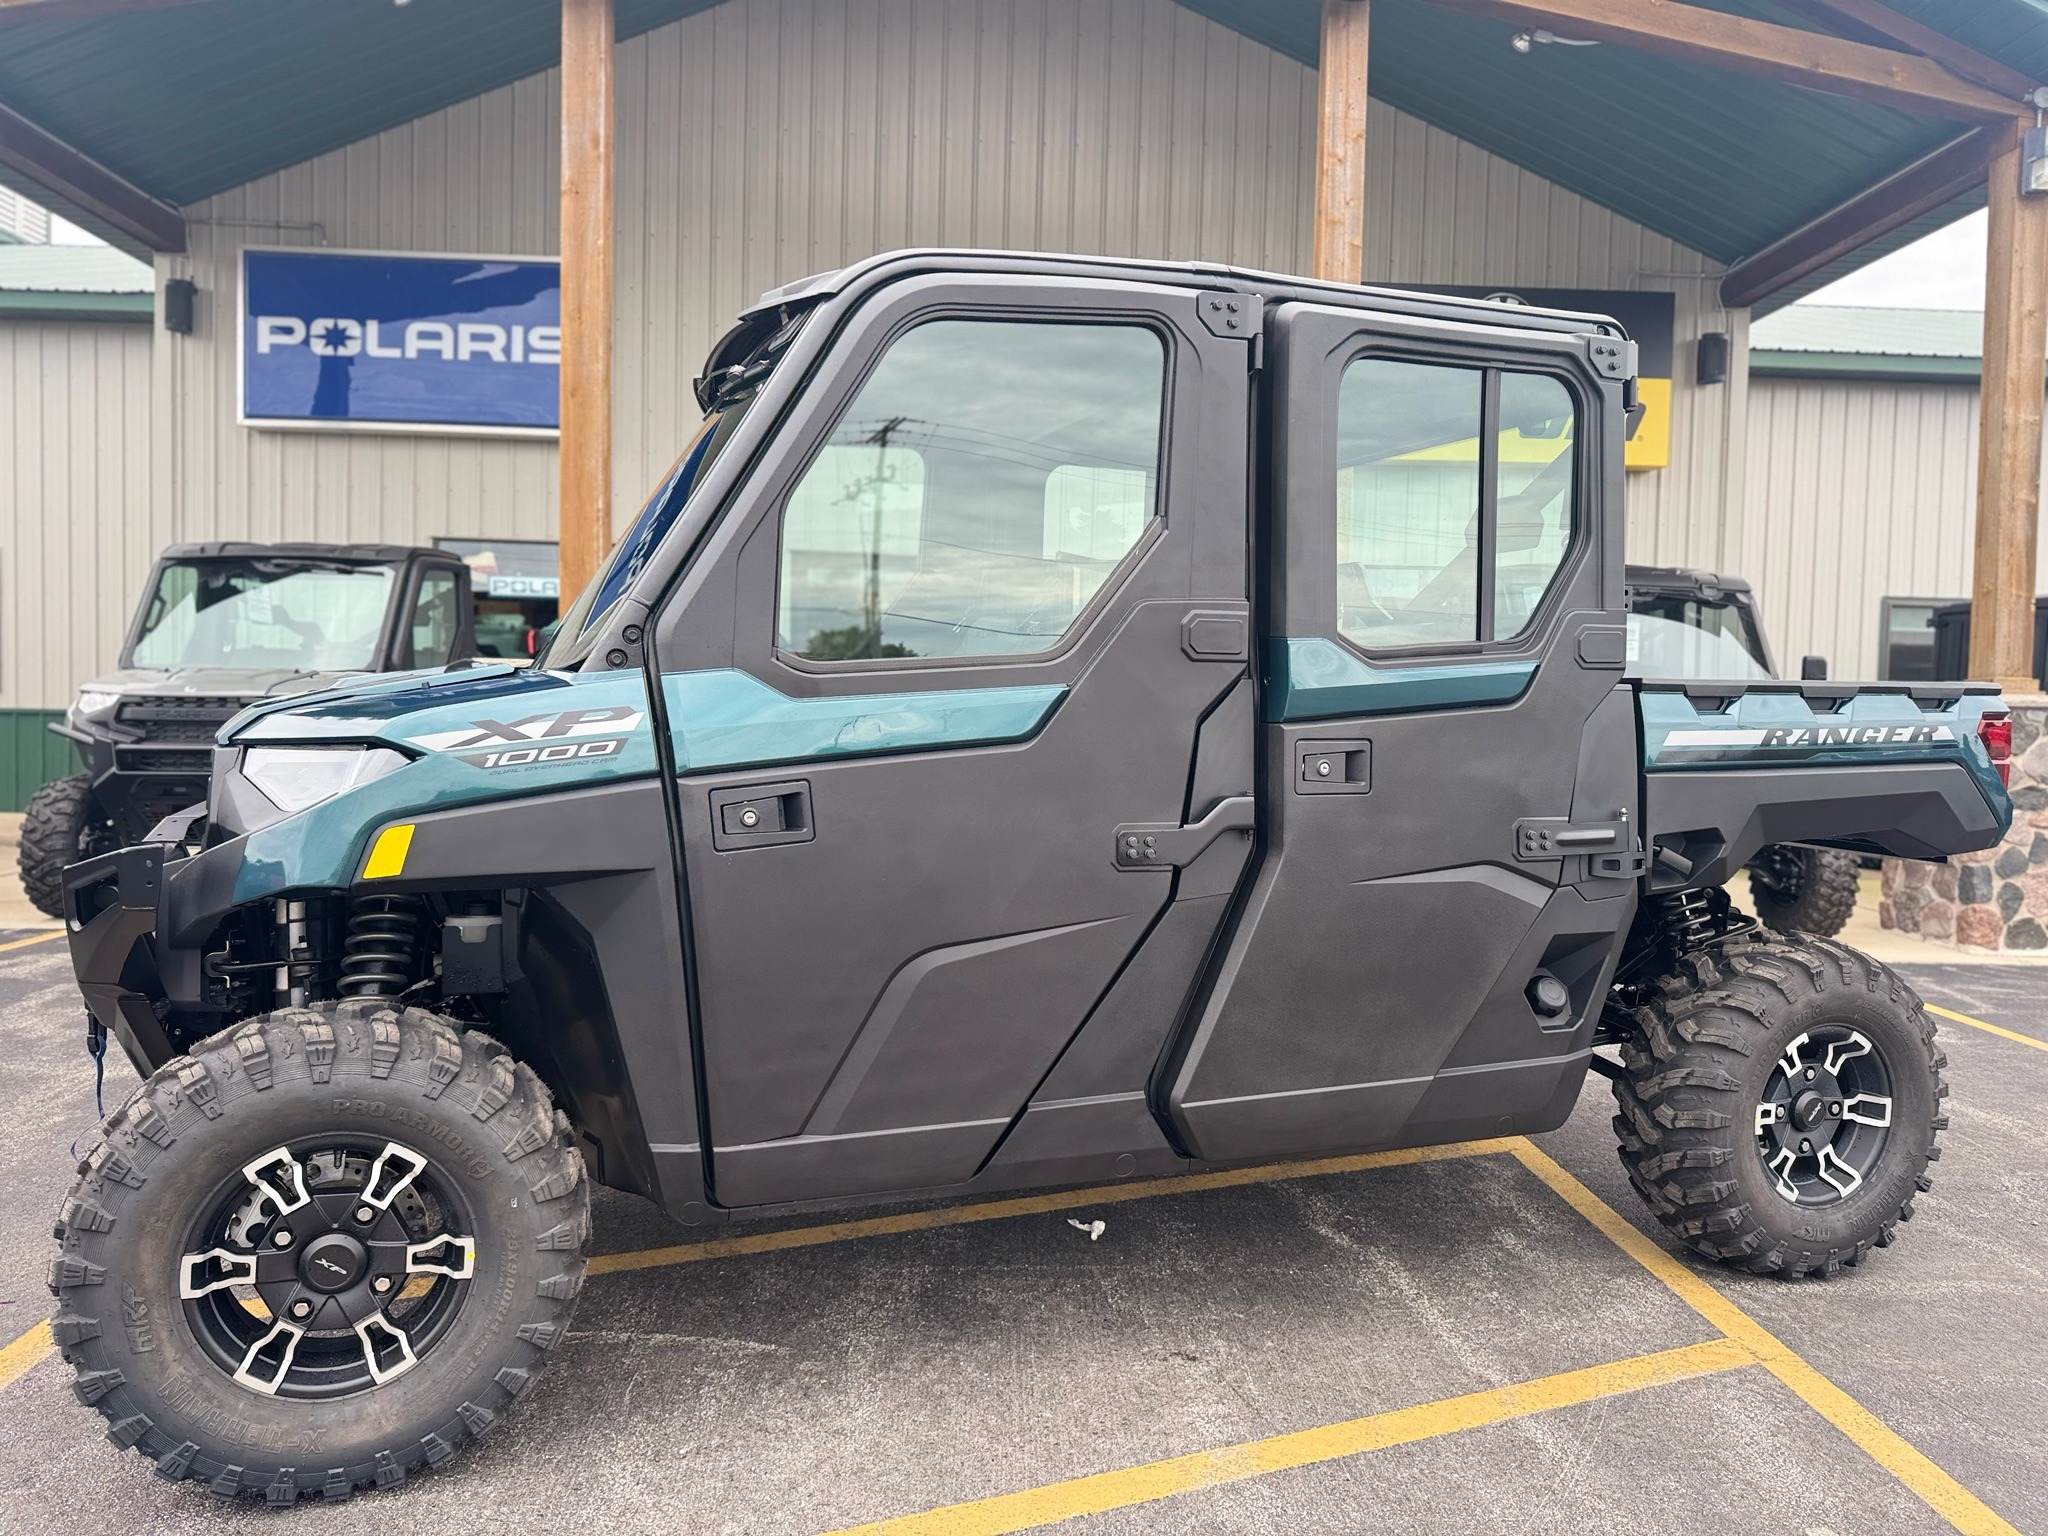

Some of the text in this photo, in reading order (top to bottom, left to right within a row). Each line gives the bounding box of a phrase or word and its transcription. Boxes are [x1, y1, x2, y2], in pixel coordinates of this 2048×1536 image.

[257, 316, 561, 364] POLARIS
[493, 580, 558, 594] POLA
[444, 706, 637, 749] XP
[1760, 724, 1939, 748] RANGER
[484, 740, 618, 768] 1000
[489, 756, 618, 776] DUAL OVERHEAD CAM
[331, 1098, 476, 1162] PRO ARMOR
[314, 1257, 348, 1275] XP
[156, 1374, 327, 1454] X-TERRAIN
